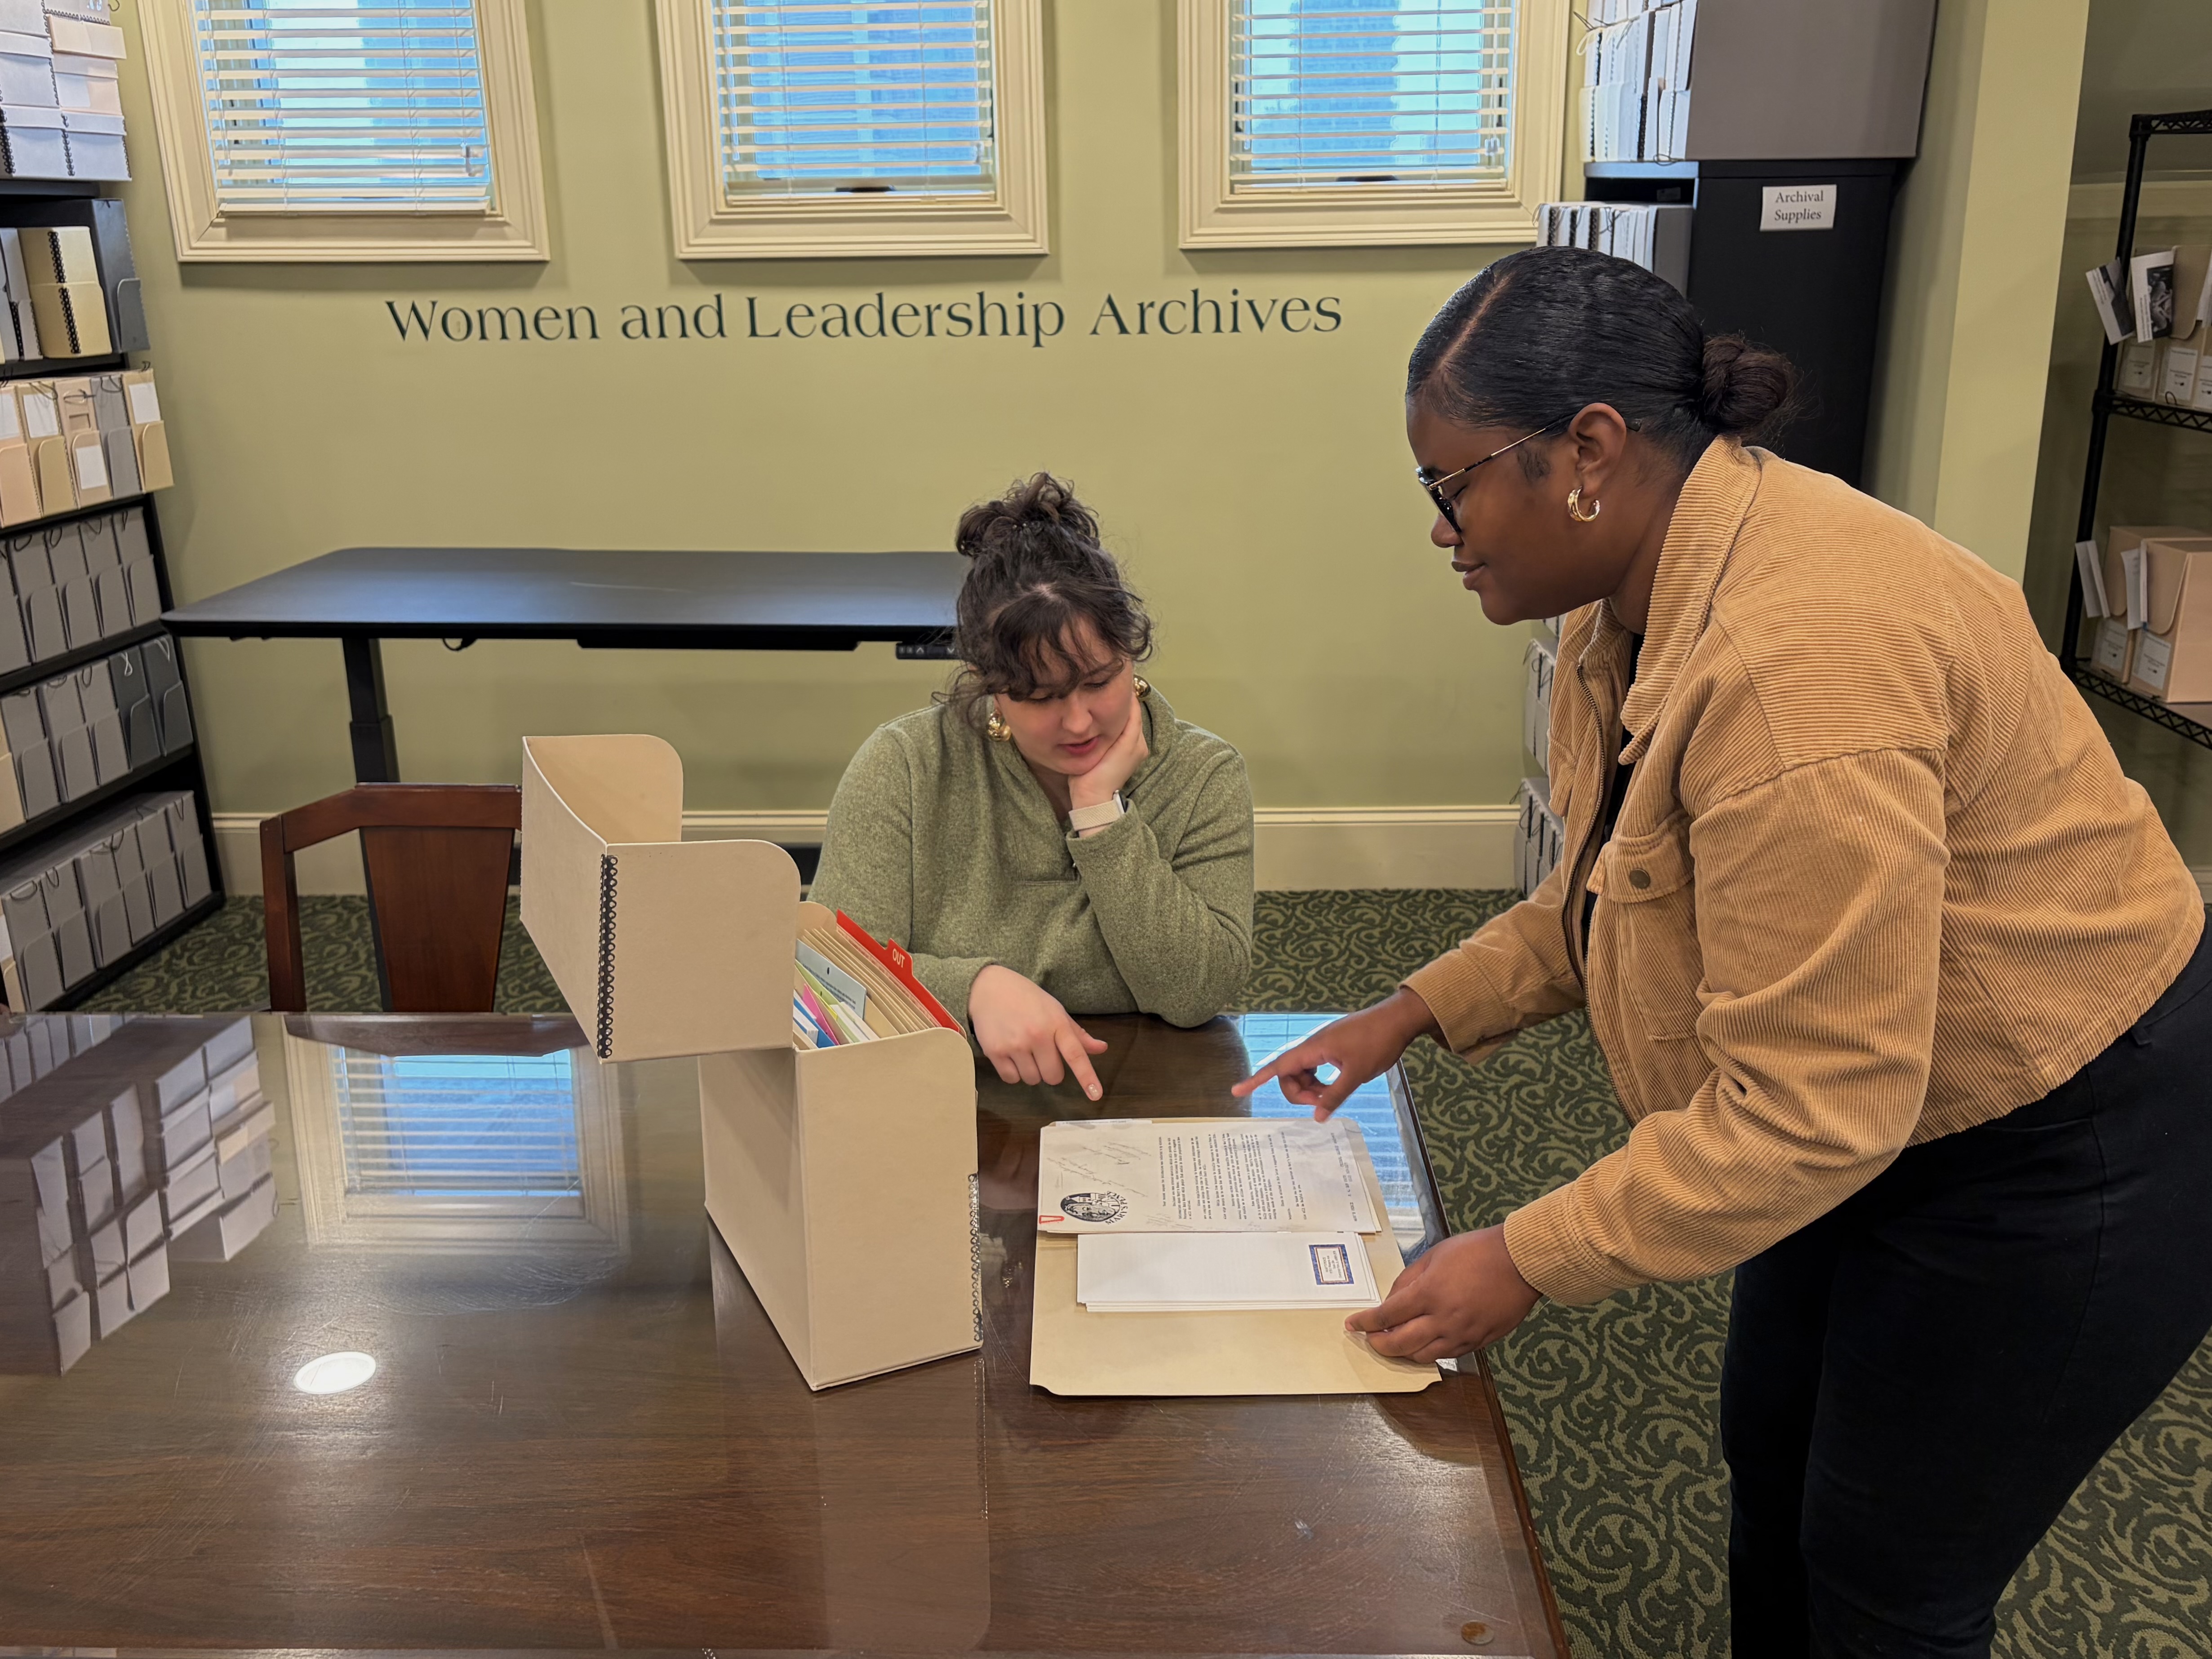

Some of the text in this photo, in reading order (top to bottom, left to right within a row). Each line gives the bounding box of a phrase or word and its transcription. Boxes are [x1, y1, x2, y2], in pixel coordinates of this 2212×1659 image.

[1775, 190, 1824, 203] Archival
[1774, 208, 1821, 224] Supplies
[386, 288, 1342, 347] Women and Leadership Archives
[893, 948, 905, 968] OUT
